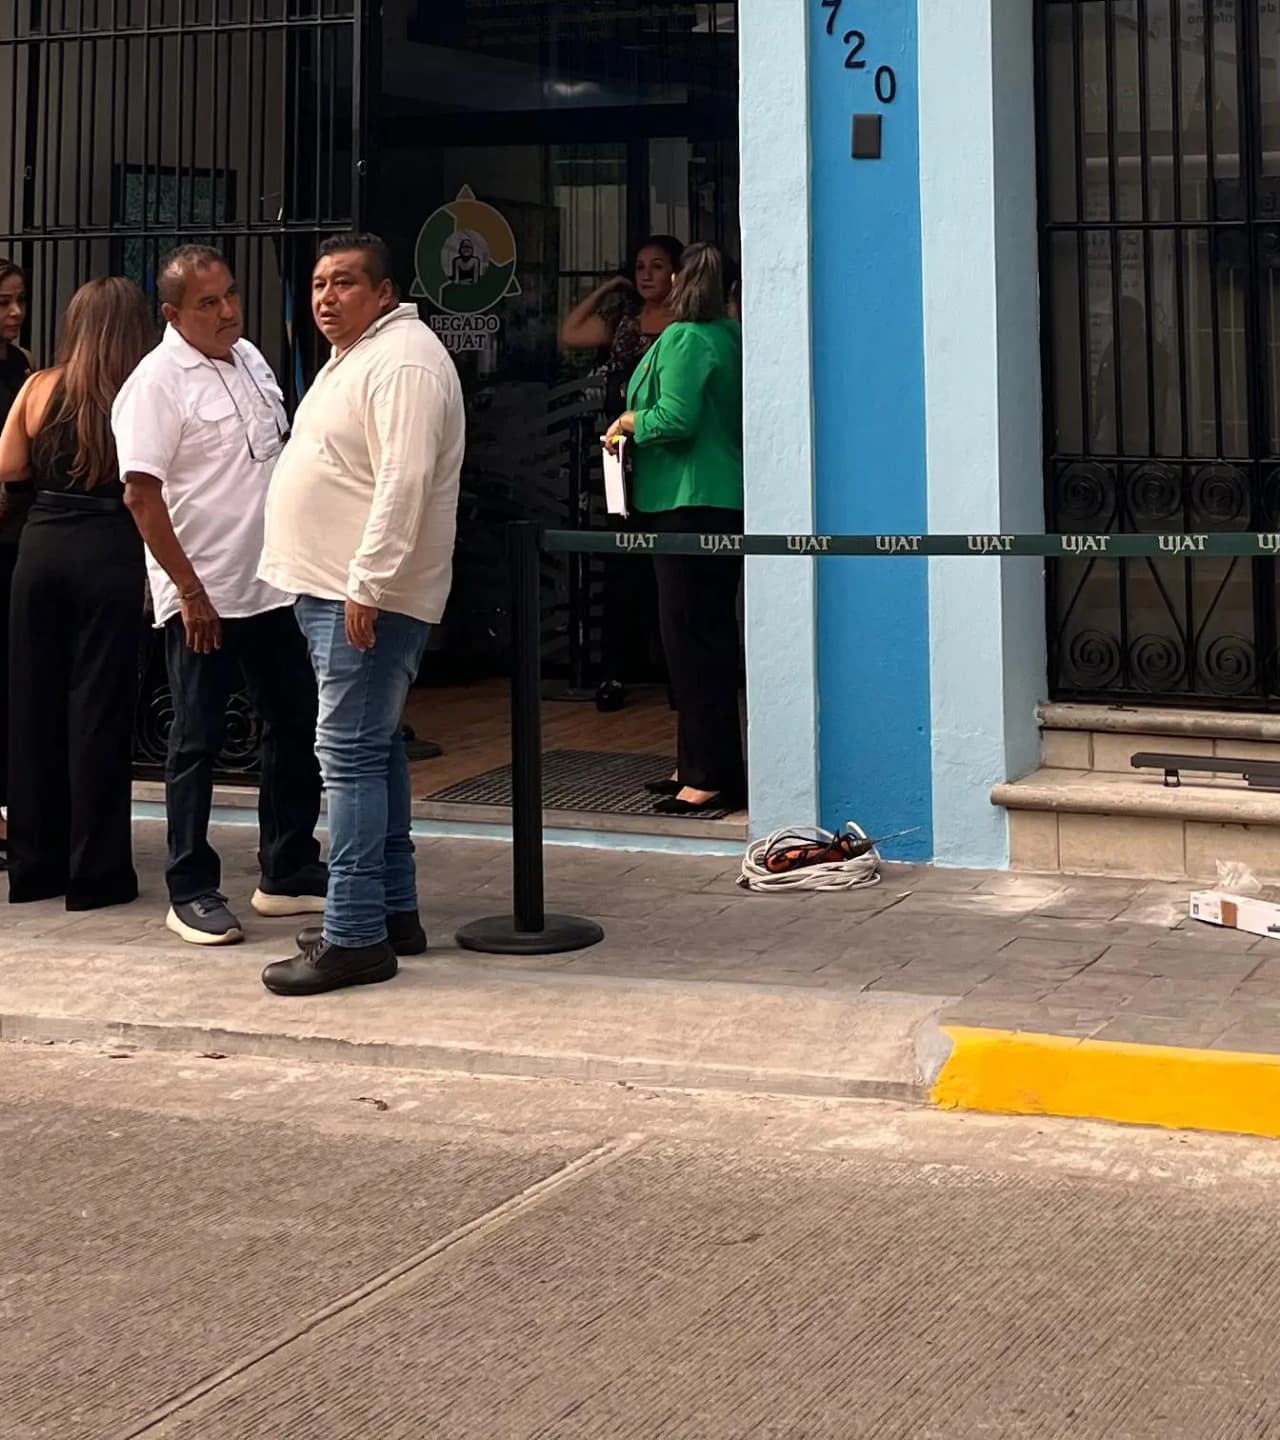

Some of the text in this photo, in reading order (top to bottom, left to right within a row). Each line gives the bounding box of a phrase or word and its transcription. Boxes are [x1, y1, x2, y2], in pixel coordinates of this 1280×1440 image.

[430, 315, 499, 333] LEGADO
[443, 333, 487, 353] UJAT
[615, 533, 658, 550] UJAT
[700, 534, 744, 552] UJAT
[786, 535, 831, 553] UJAT
[875, 535, 922, 554] UJAT
[967, 535, 1014, 553] UJAT
[1061, 535, 1110, 554] UJAT
[1158, 535, 1208, 554] UJAT
